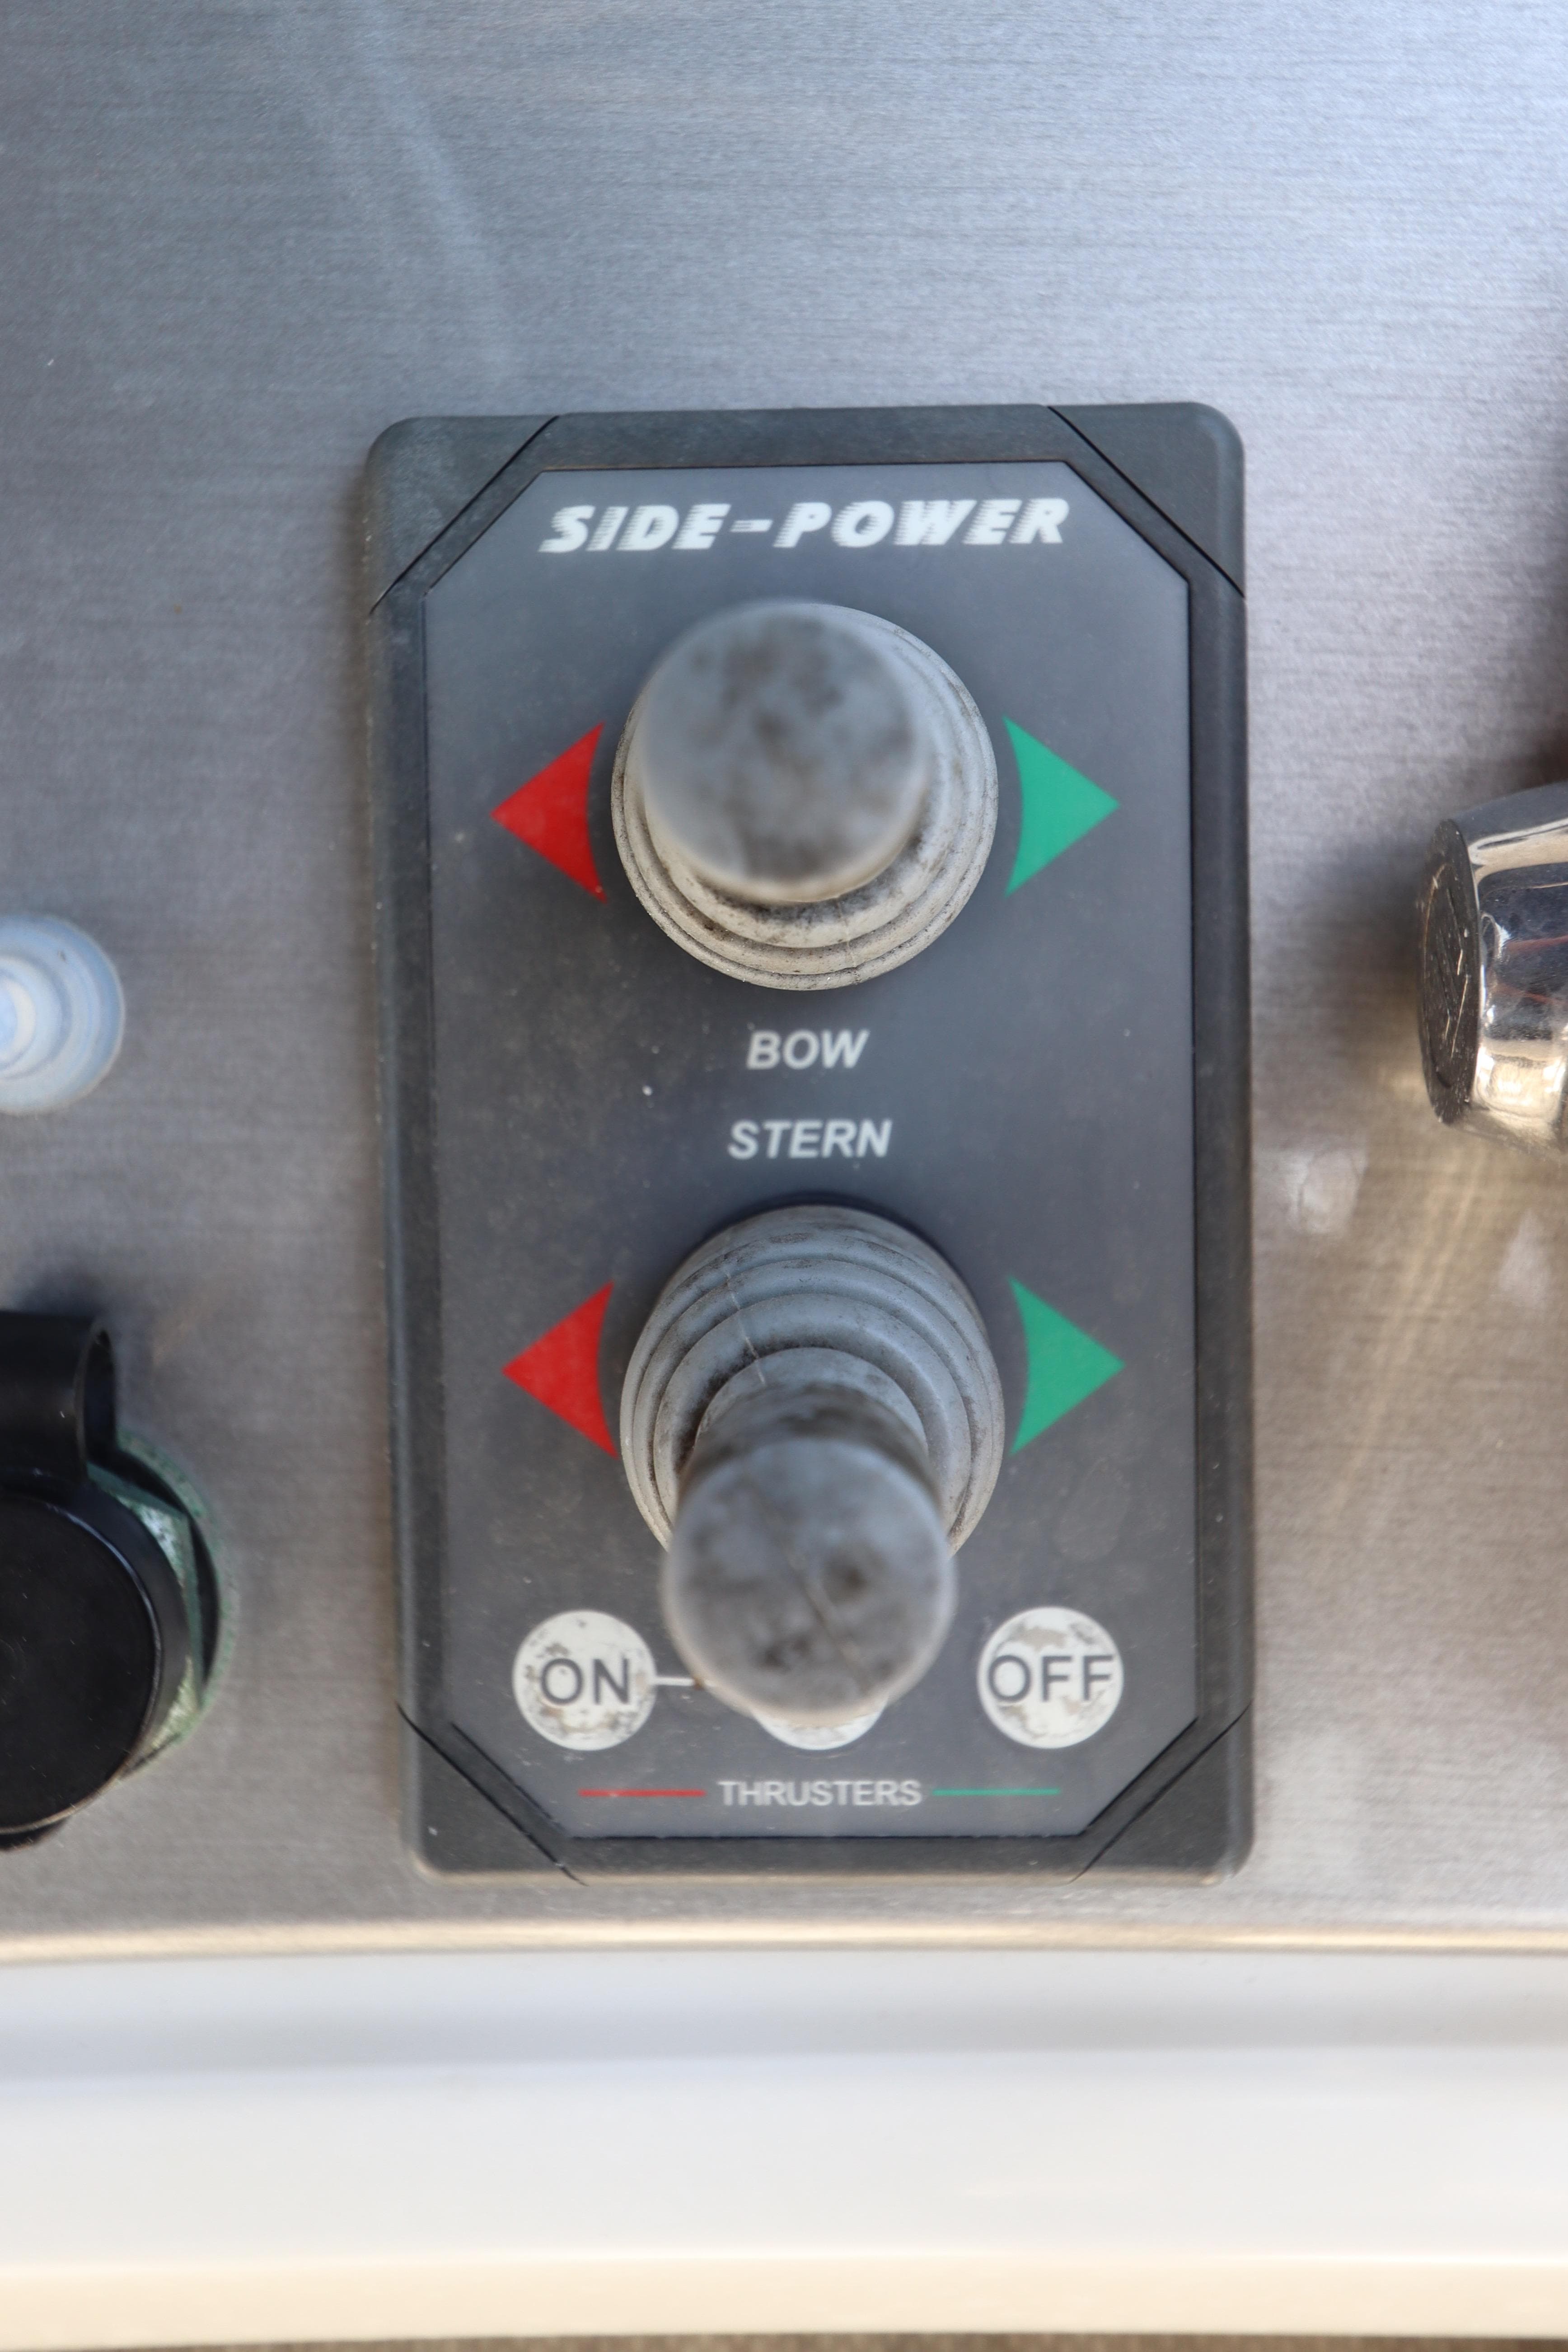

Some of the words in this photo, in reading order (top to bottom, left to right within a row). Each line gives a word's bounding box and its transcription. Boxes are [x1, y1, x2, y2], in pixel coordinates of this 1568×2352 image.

[539, 498, 1070, 553] SIDE-POWER
[746, 1029, 870, 1070] BOW
[727, 1118, 893, 1160] STERN
[540, 1657, 630, 1706] ON
[988, 1654, 1114, 1702] OFF
[718, 1780, 922, 1807] THRUSTERS
